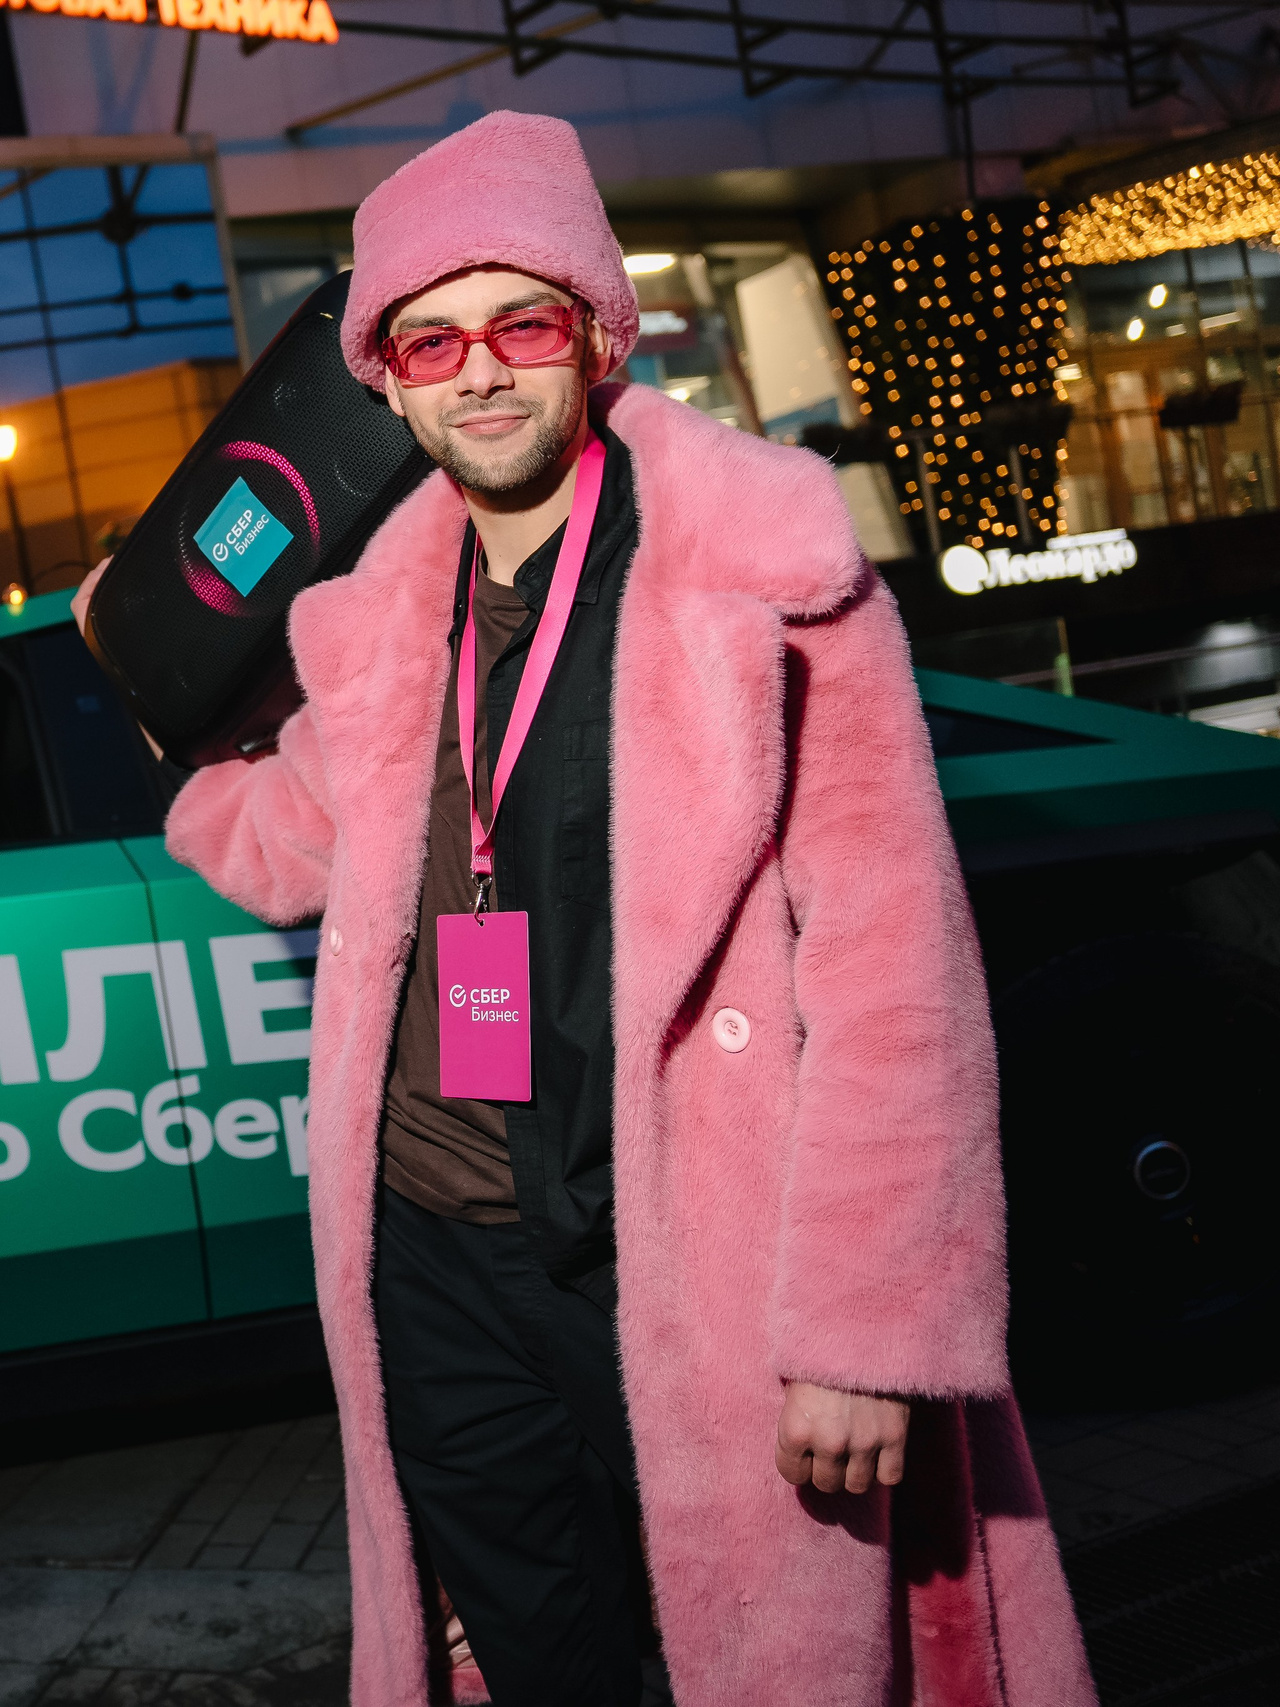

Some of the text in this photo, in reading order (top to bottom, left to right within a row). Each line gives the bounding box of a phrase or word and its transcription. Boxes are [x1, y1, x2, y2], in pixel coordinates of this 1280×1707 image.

[157, 0, 340, 45] ТЕХНИКА
[225, 509, 253, 545] СБЕР
[234, 514, 270, 556] Бизнес
[470, 988, 510, 1004] СБЕР
[471, 1006, 520, 1022] Бизнес
